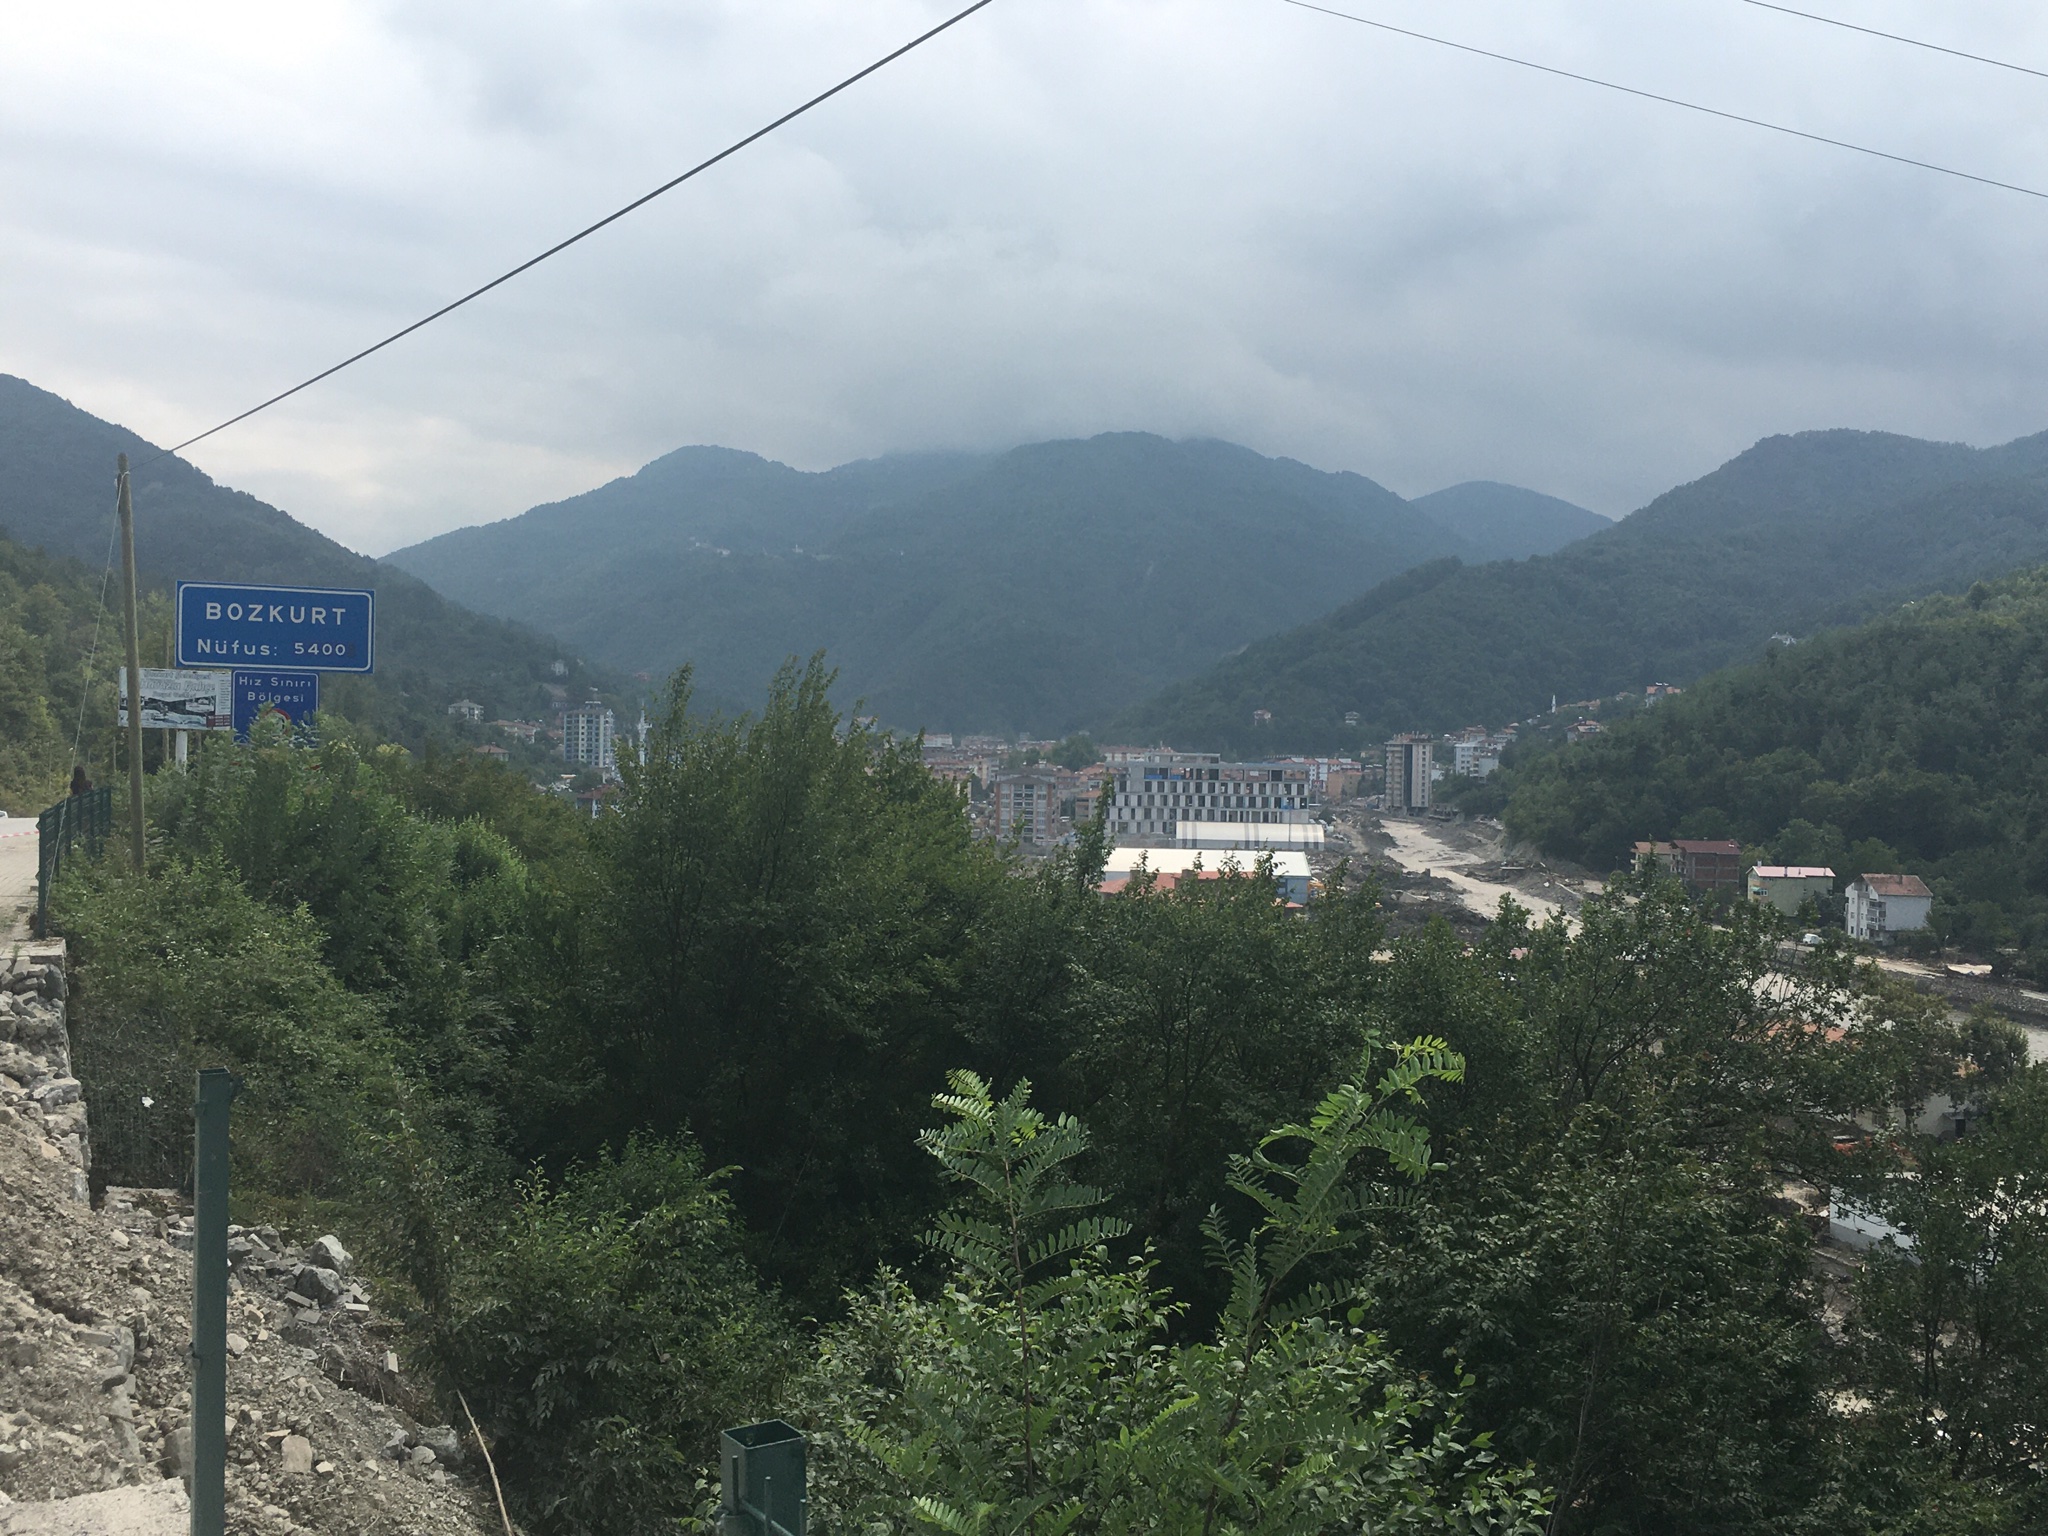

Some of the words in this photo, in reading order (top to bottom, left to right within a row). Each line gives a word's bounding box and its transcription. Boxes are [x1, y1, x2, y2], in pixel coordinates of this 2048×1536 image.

[206, 602, 346, 625] BOZKURT
[197, 639, 278, 656] Nüfus:
[294, 642, 346, 656] 5400
[239, 676, 261, 686] Hız
[270, 677, 311, 688] Sınırı
[247, 691, 304, 703] Bölgesi
